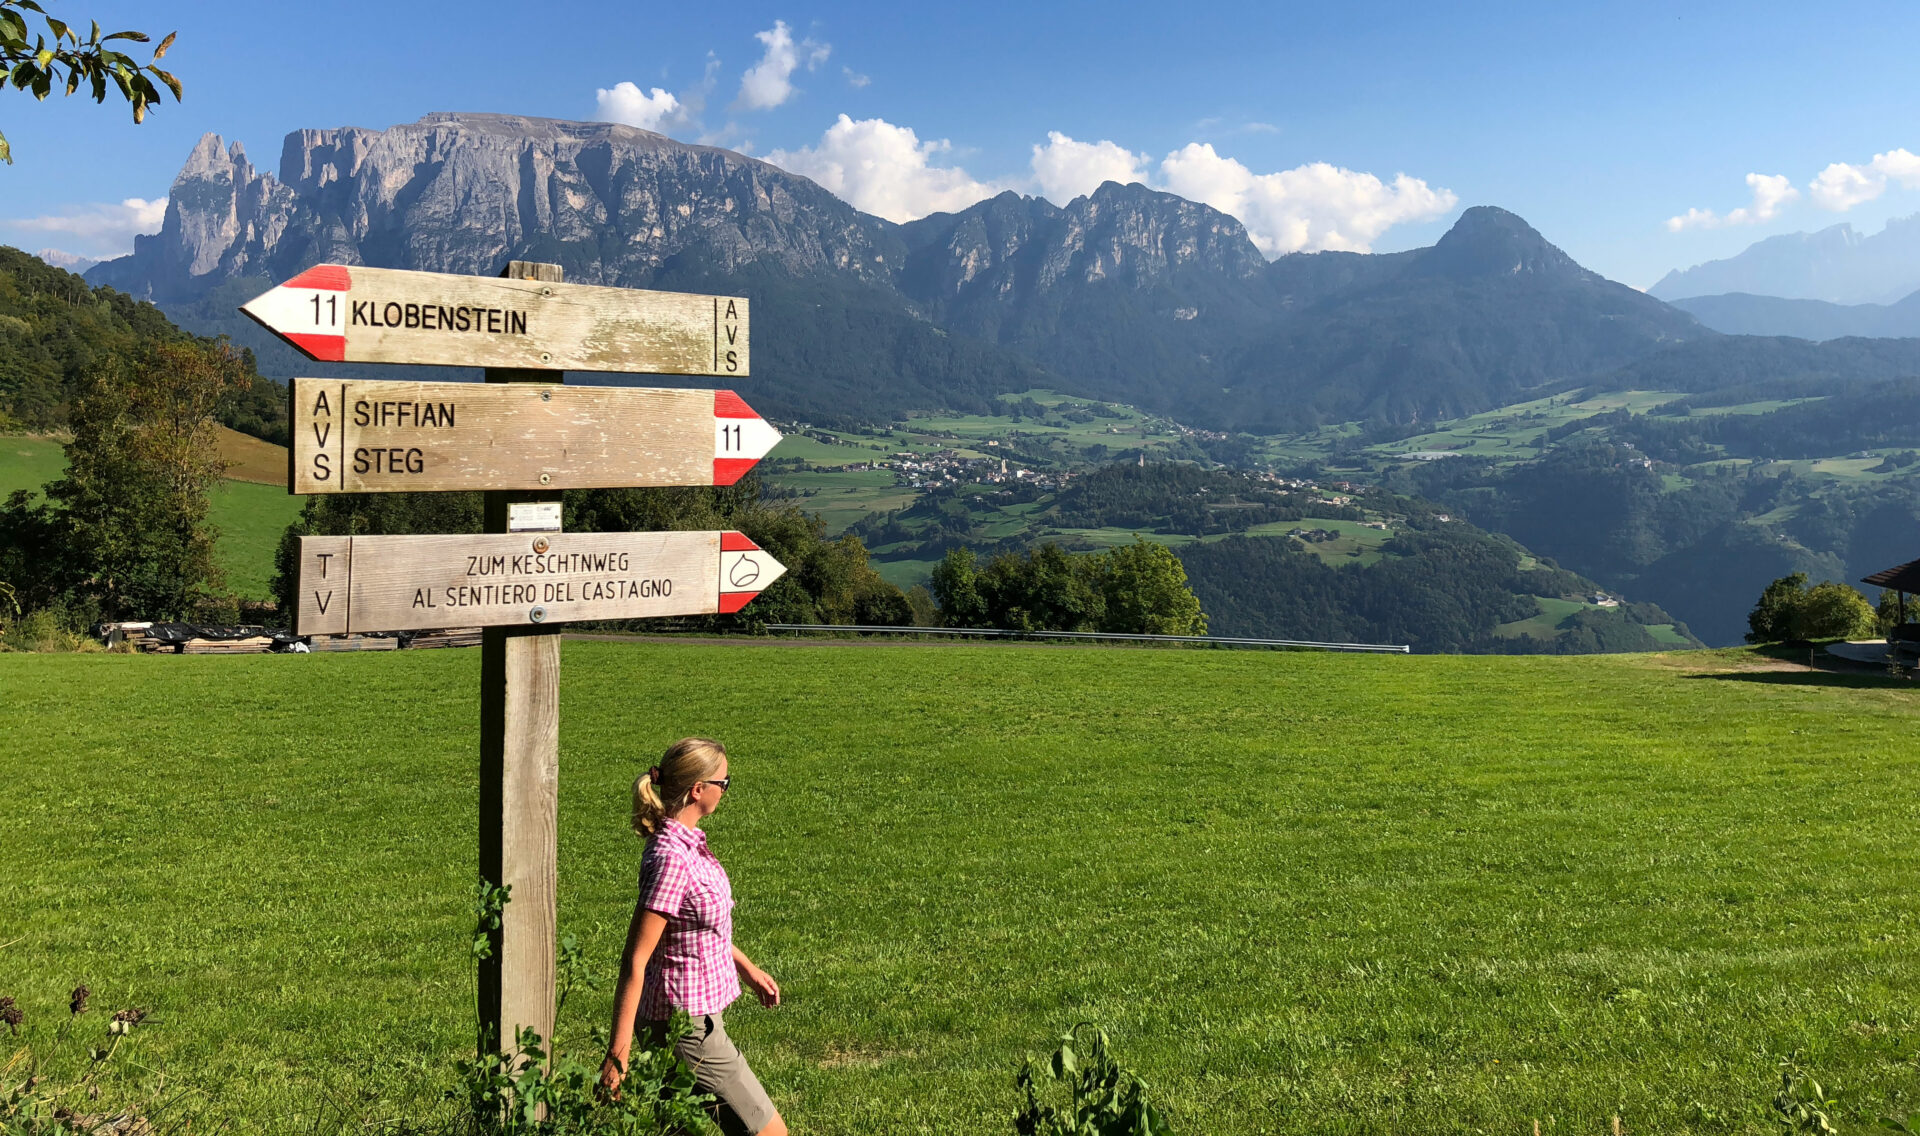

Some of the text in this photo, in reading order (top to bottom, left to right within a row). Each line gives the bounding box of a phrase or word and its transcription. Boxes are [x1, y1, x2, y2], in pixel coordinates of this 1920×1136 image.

[310, 293, 527, 335] 11 KLOBENSTEIN
[353, 400, 455, 428] SIFFIAN
[722, 424, 741, 452] 11
[353, 447, 424, 475] STEG
[466, 551, 629, 577] ZUM KESCHTNWEG
[412, 578, 672, 609] AL SENTIERO DEL CASTAGNO
